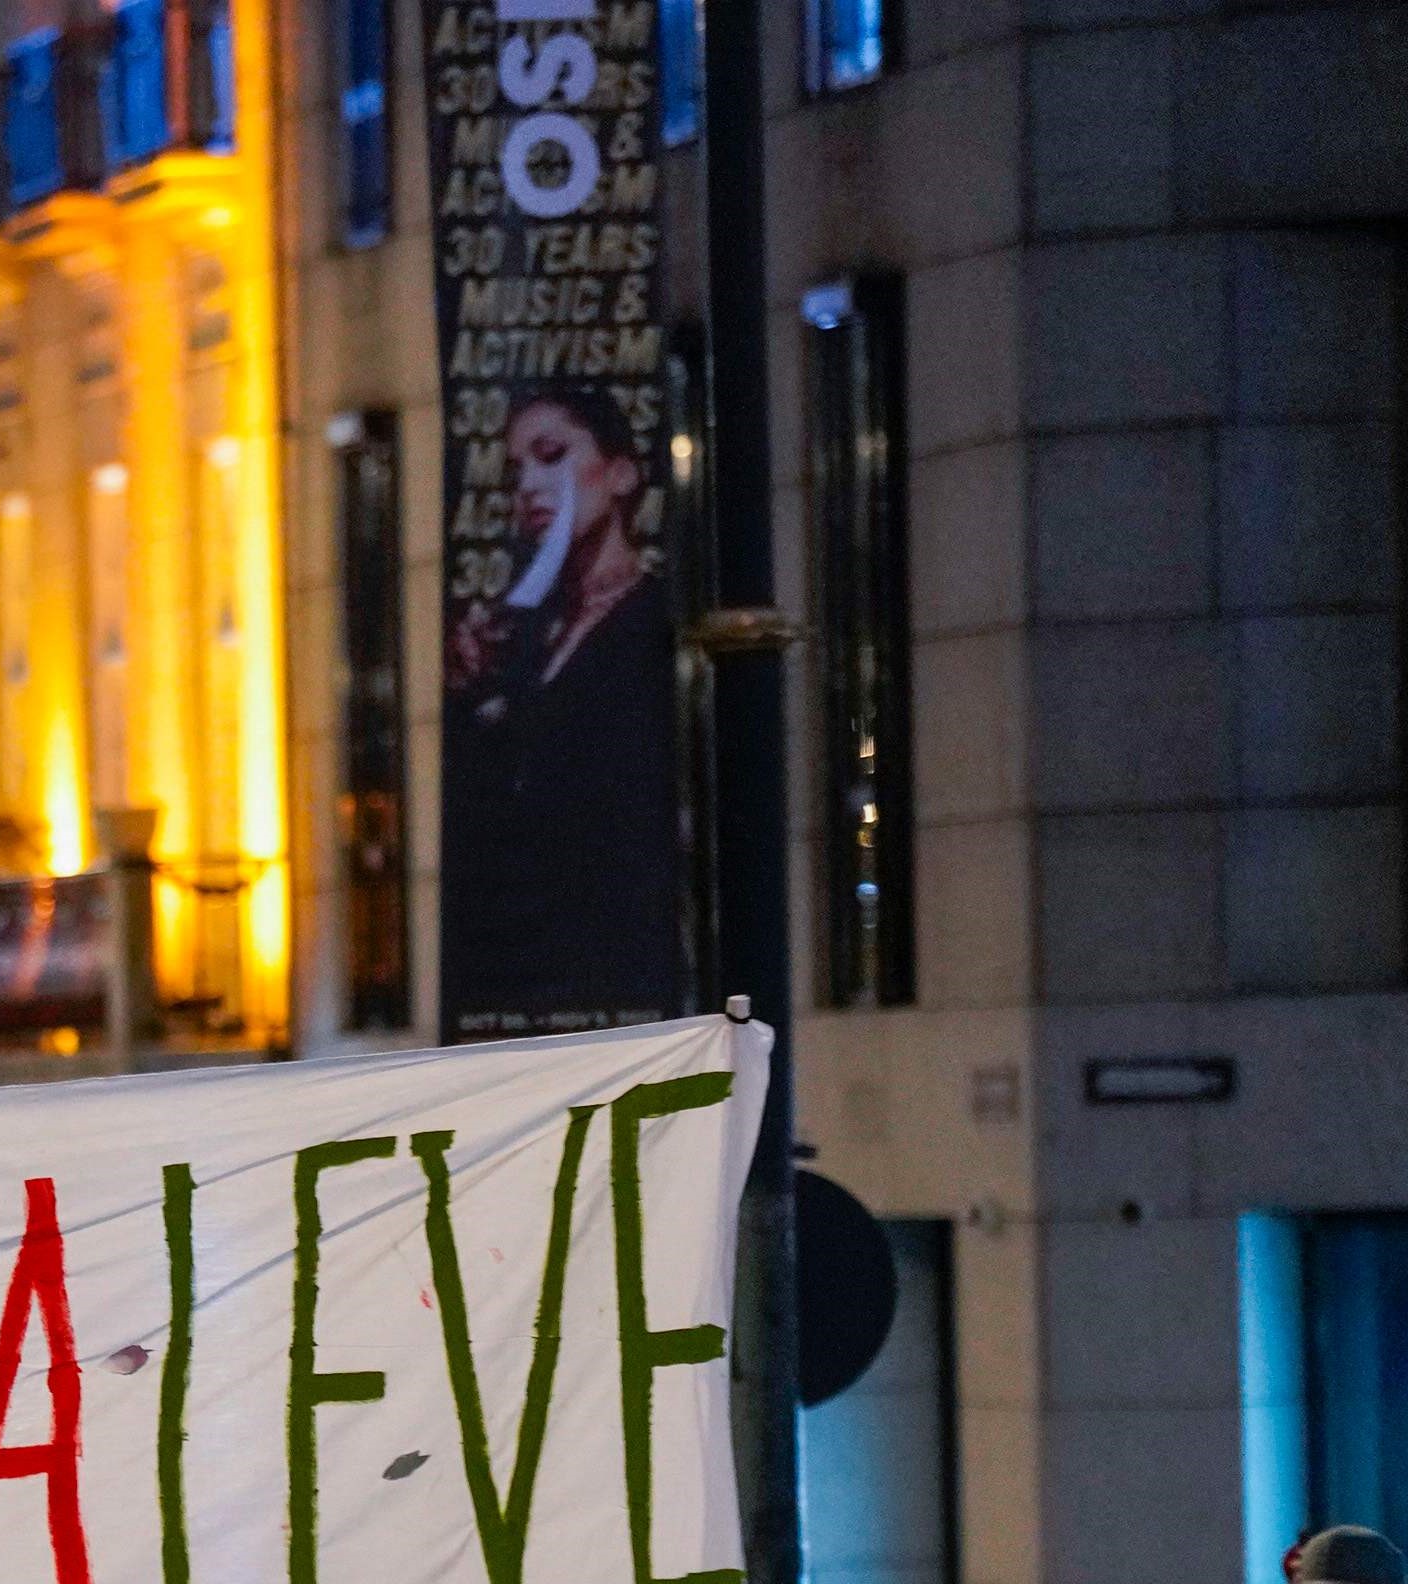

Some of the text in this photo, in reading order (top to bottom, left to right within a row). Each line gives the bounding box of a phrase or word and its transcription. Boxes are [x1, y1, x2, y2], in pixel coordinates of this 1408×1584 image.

[443, 223, 659, 277] 30 YEARS
[459, 273, 648, 325] MUSIC &
[450, 324, 663, 378] ACTIVISM
